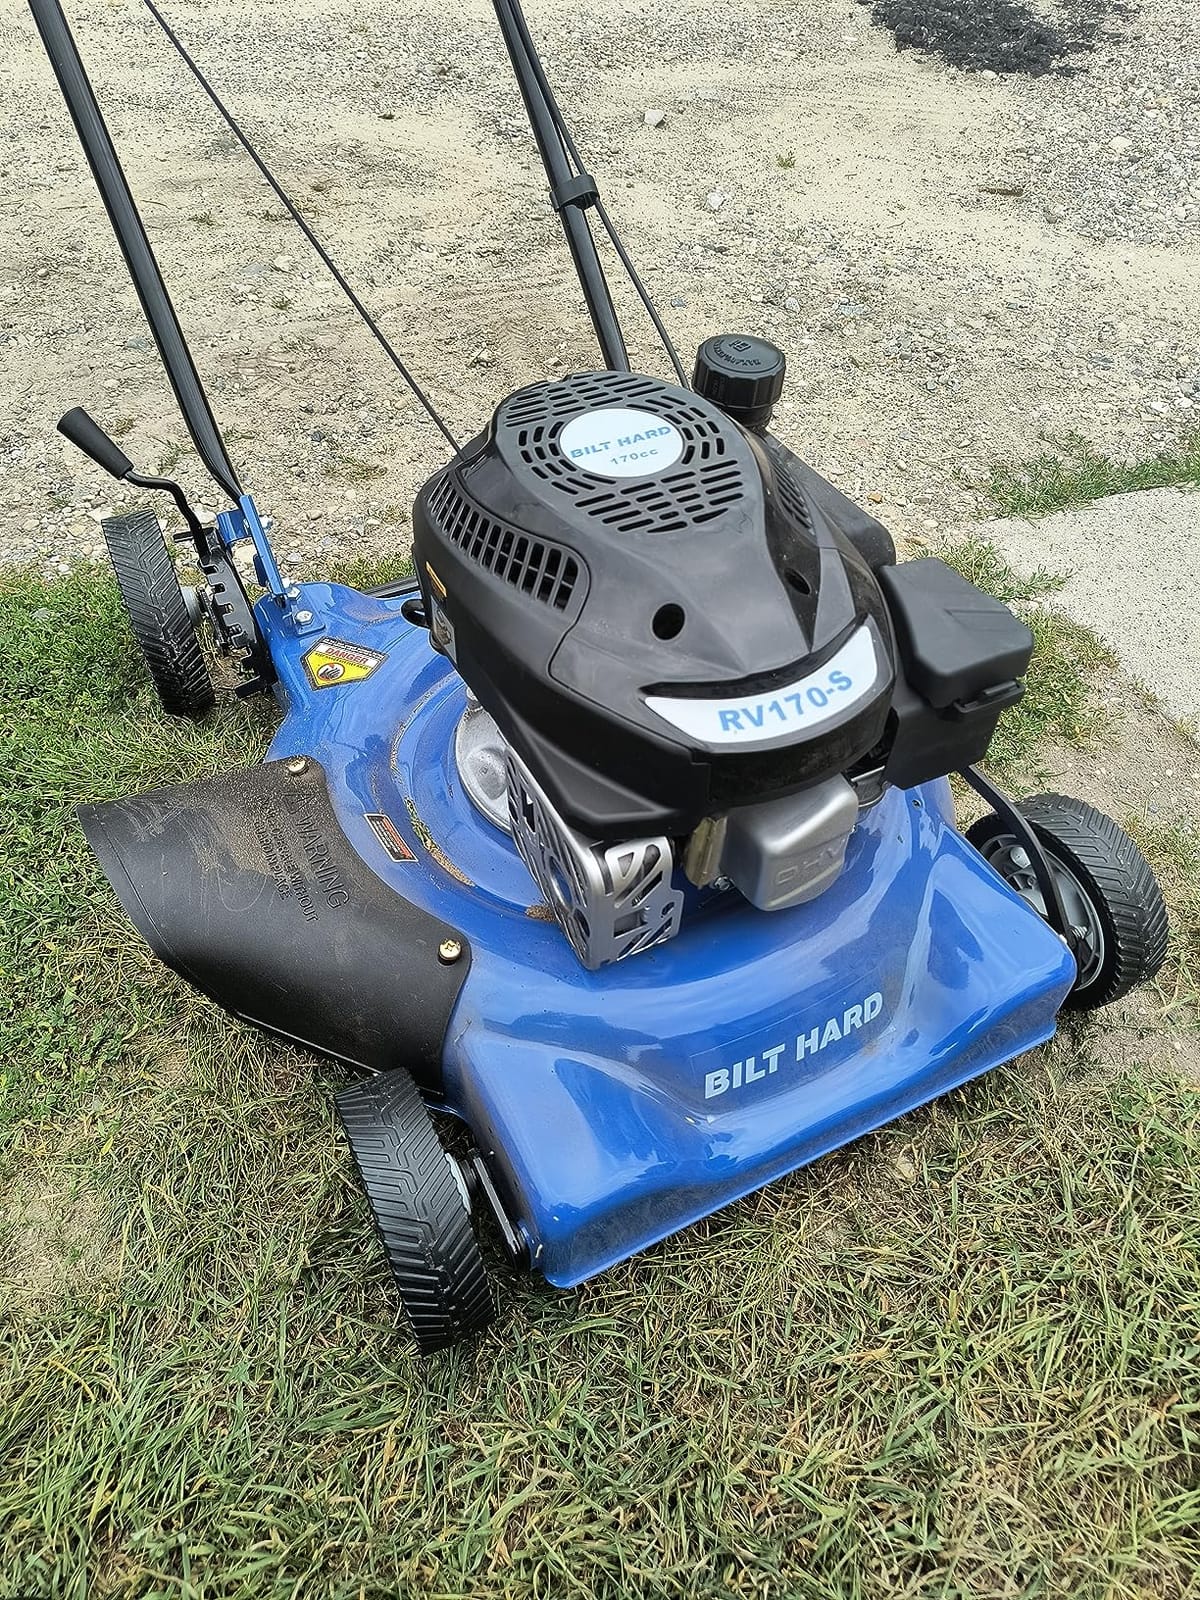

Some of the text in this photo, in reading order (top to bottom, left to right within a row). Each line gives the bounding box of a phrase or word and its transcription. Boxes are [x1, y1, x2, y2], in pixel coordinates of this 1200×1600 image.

[570, 426, 671, 458] BILT HARD
[610, 449, 659, 465] 170cc
[325, 647, 369, 664] DANGER
[718, 670, 853, 732] RV170-S
[272, 863, 292, 900] PLACE
[296, 813, 350, 909] WARNING
[290, 871, 319, 922] WITHOUT
[704, 991, 883, 1099] BILT HARD
